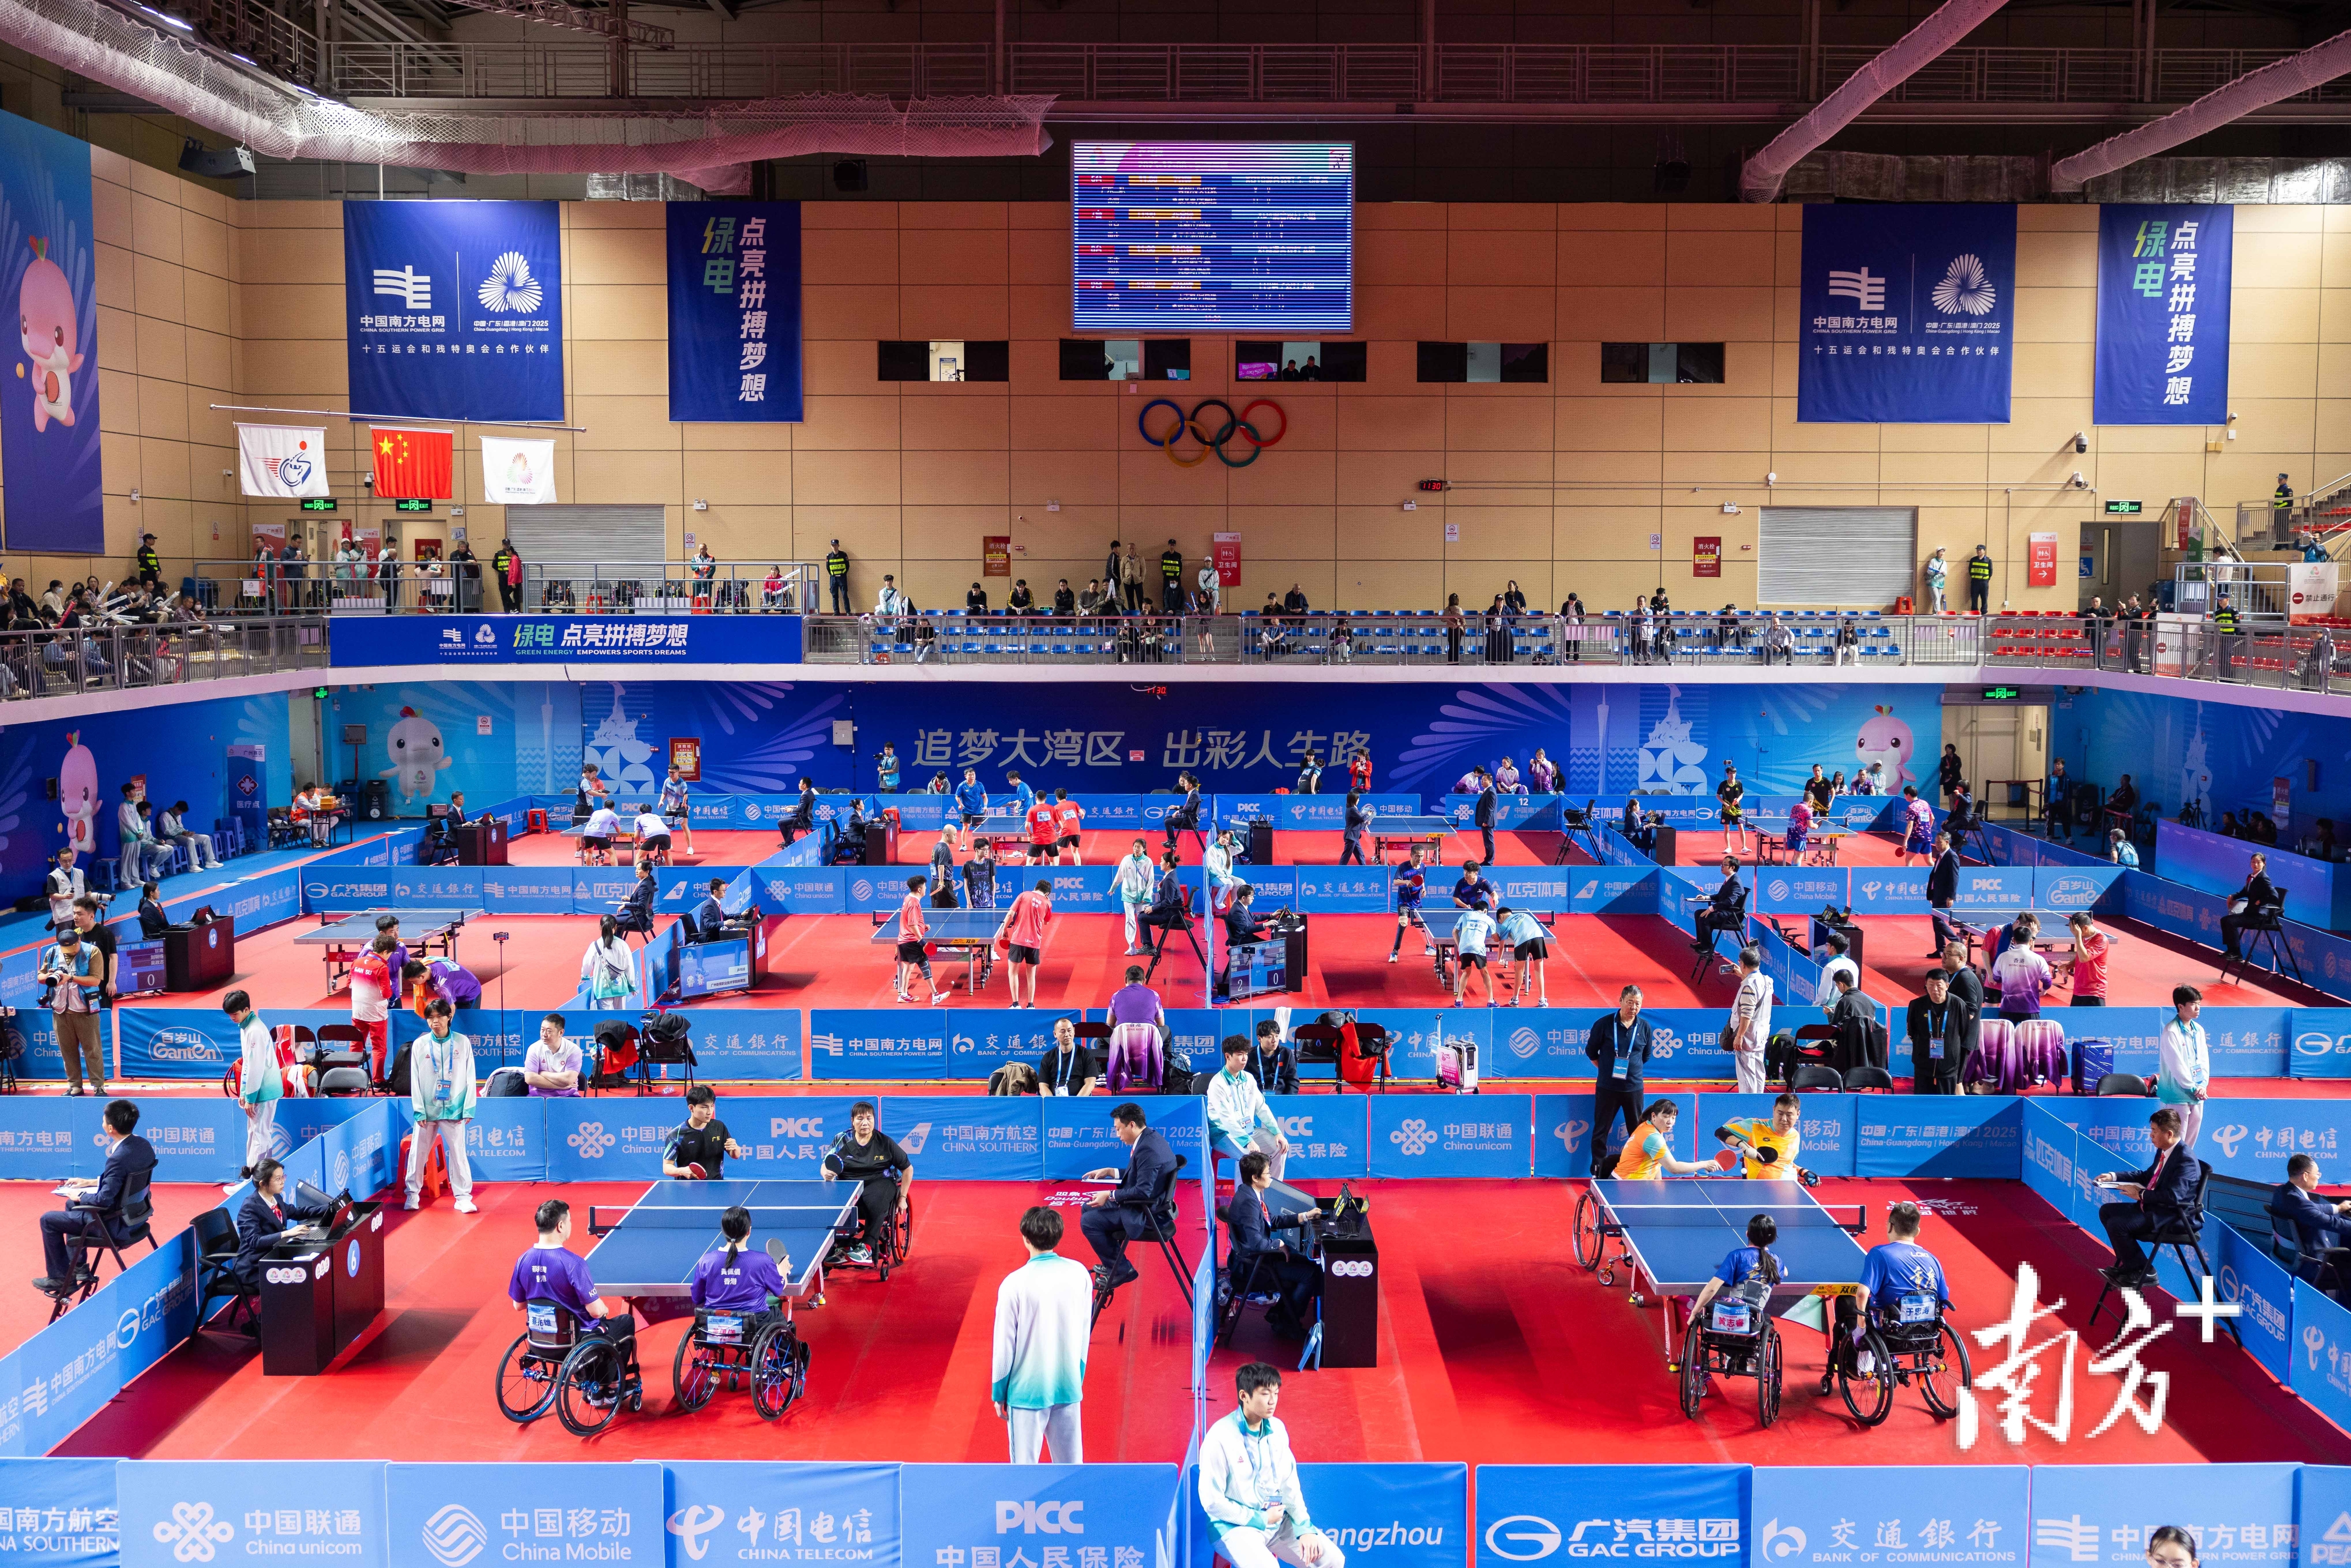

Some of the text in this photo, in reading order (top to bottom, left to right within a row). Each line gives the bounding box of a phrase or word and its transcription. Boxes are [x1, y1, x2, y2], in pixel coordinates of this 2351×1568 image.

[702, 217, 736, 293] 绿电
[2133, 221, 2169, 297] 绿电
[739, 217, 767, 401] 点亮拼搏梦想
[2163, 221, 2199, 405] 点亮拼搏梦想
[360, 316, 445, 327] 中国南方电网
[1813, 317, 1897, 328] 中国南方电网
[362, 344, 548, 353] 十五运会和残特奥会合作伙伴
[1814, 346, 1999, 355] 十五运会和残特奥会合作伙伴
[2306, 594, 2335, 602] 禁止通行
[514, 624, 688, 647] 绿电 点亮拼搏梦想
[912, 728, 1371, 769] 追梦大湾区 出彩人生路
[693, 806, 728, 816] 中国电信
[1309, 806, 1343, 815] 中国电信
[331, 884, 387, 892] 广汽集团
[418, 883, 472, 894] 交通銀行
[795, 883, 833, 892] 中国联通
[1054, 877, 1083, 889] PICC
[1324, 882, 1380, 893] 交通銀行
[1604, 882, 1657, 891] 中国南方航空
[1794, 882, 1837, 892] 中国移动
[1973, 879, 2001, 890] PICC
[2059, 881, 2093, 890] 百岁山
[508, 885, 571, 895] 中国南方电网
[1507, 882, 1567, 898] 匹克体育
[210, 935, 216, 945] 12
[1238, 980, 1242, 992] 2
[161, 1032, 201, 1044] 百岁山
[705, 1033, 790, 1050] 交通銀行
[849, 1038, 942, 1051] 中国南方电网
[1548, 1046, 1576, 1055] China
[34, 1048, 62, 1057] China
[770, 1118, 822, 1138] PICC
[943, 1126, 1037, 1140] 中国南方航空
[1169, 1127, 1202, 1138] 2025
[1444, 1123, 1512, 1139] 中国联通
[1984, 1126, 2017, 1138] 2025
[147, 1127, 215, 1143] 中国联通
[2255, 1126, 2337, 1151] 中国电信
[622, 1145, 653, 1153] China
[942, 1142, 1037, 1152] CHINA SOUTHERN
[1444, 1141, 1512, 1151] China unicom
[1802, 1141, 1840, 1151] Mobile
[1939, 1139, 1959, 1148] Hong
[178, 1145, 215, 1155] unicom
[350, 1250, 357, 1267] 6
[536, 1274, 547, 1283] 香港
[724, 1277, 737, 1286] 香港
[2241, 1283, 2286, 1327] 广汽集团
[1906, 1306, 1930, 1317] 于忠涛
[1718, 1316, 1744, 1328] 黄志睿
[51, 1330, 116, 1394] 中国南方电网
[245, 1509, 361, 1535] 中国联通
[501, 1507, 630, 1538] 中国移动
[996, 1501, 1084, 1534] PICC
[738, 1506, 873, 1545] 中国电信
[1569, 1519, 1740, 1541] 广汽集团
[1830, 1517, 2002, 1550] 交通銀行
[24, 1535, 120, 1552] SOUTHERN
[246, 1539, 362, 1555] China unicom
[502, 1542, 631, 1561] China Mobile
[738, 1549, 873, 1560] CHINA TELECOM
[1569, 1543, 1740, 1557] GAC GROUP
[936, 1546, 1144, 1568] 中国人民保险
[1813, 1552, 2016, 1562] BANK OF COMMUNICATIONS
[2222, 1552, 2299, 1561] POWER GRID
